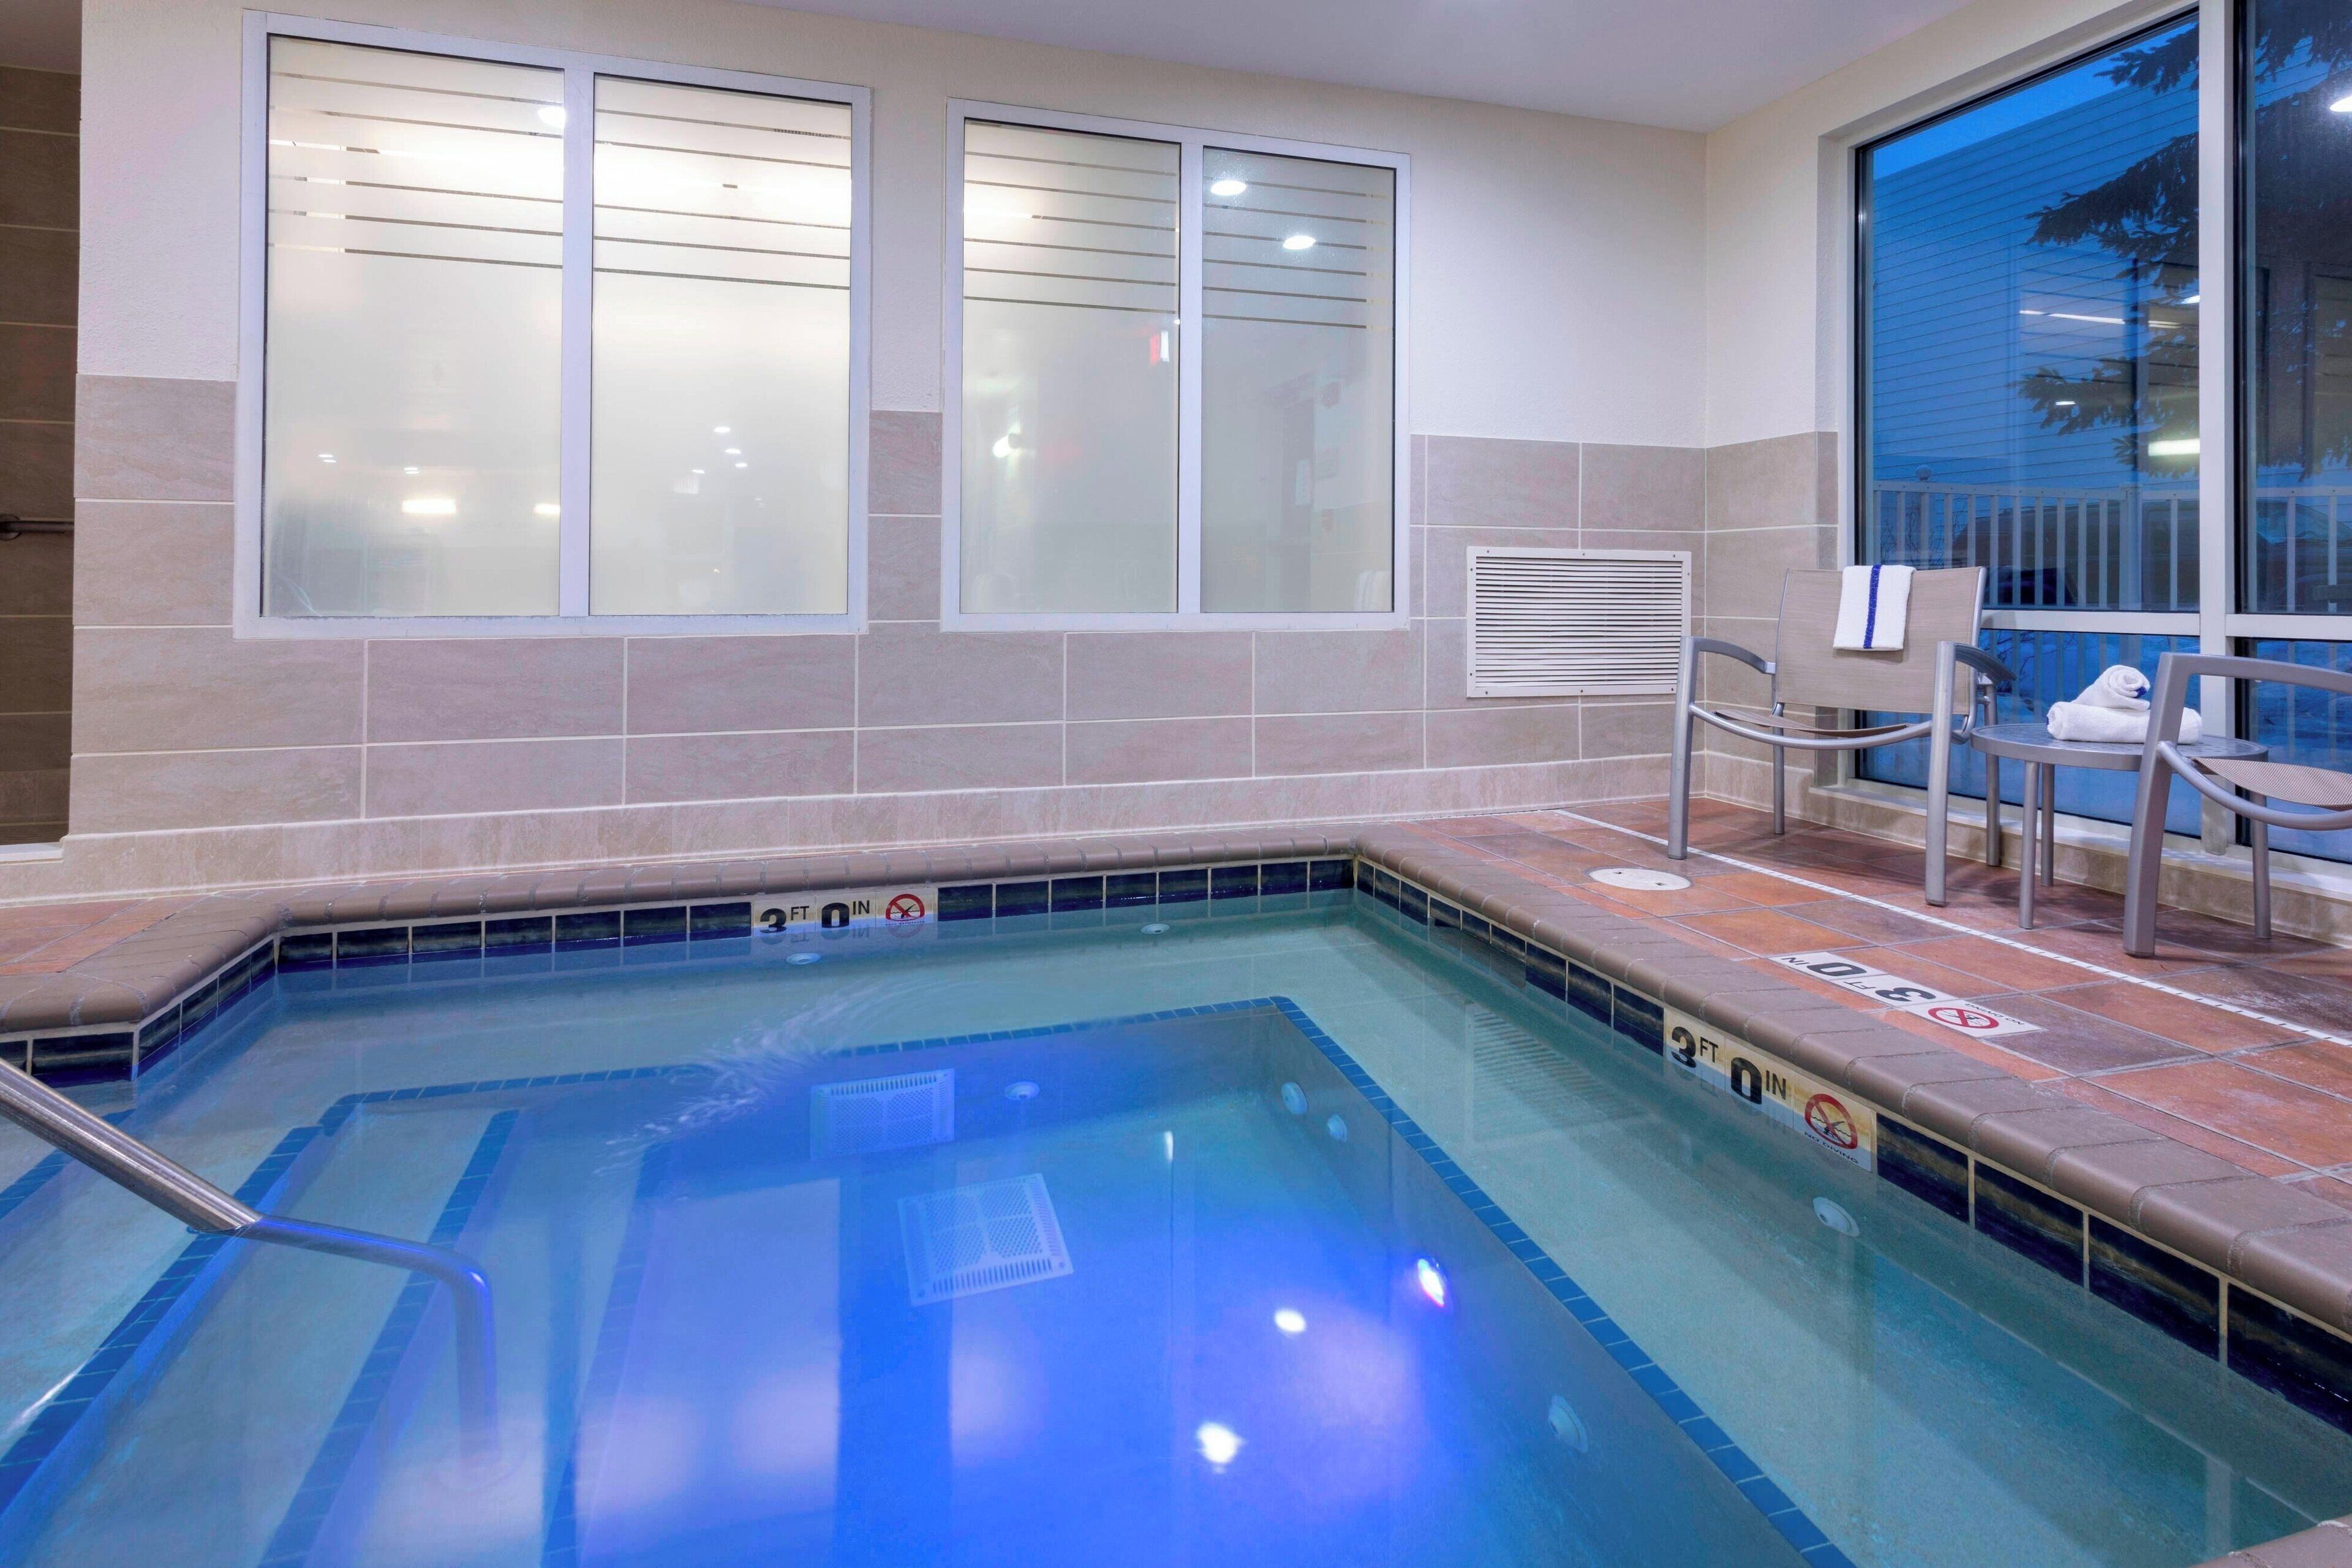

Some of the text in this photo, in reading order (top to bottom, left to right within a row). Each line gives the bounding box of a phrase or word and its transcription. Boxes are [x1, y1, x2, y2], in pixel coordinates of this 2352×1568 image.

[760, 900, 870, 933] 3 FT 0 IN
[1781, 957, 1936, 1001] 3 FT 0 IN
[1671, 1026, 1787, 1105] 3 FT 0 IN
[1804, 1131, 1859, 1164] NO DIVING
